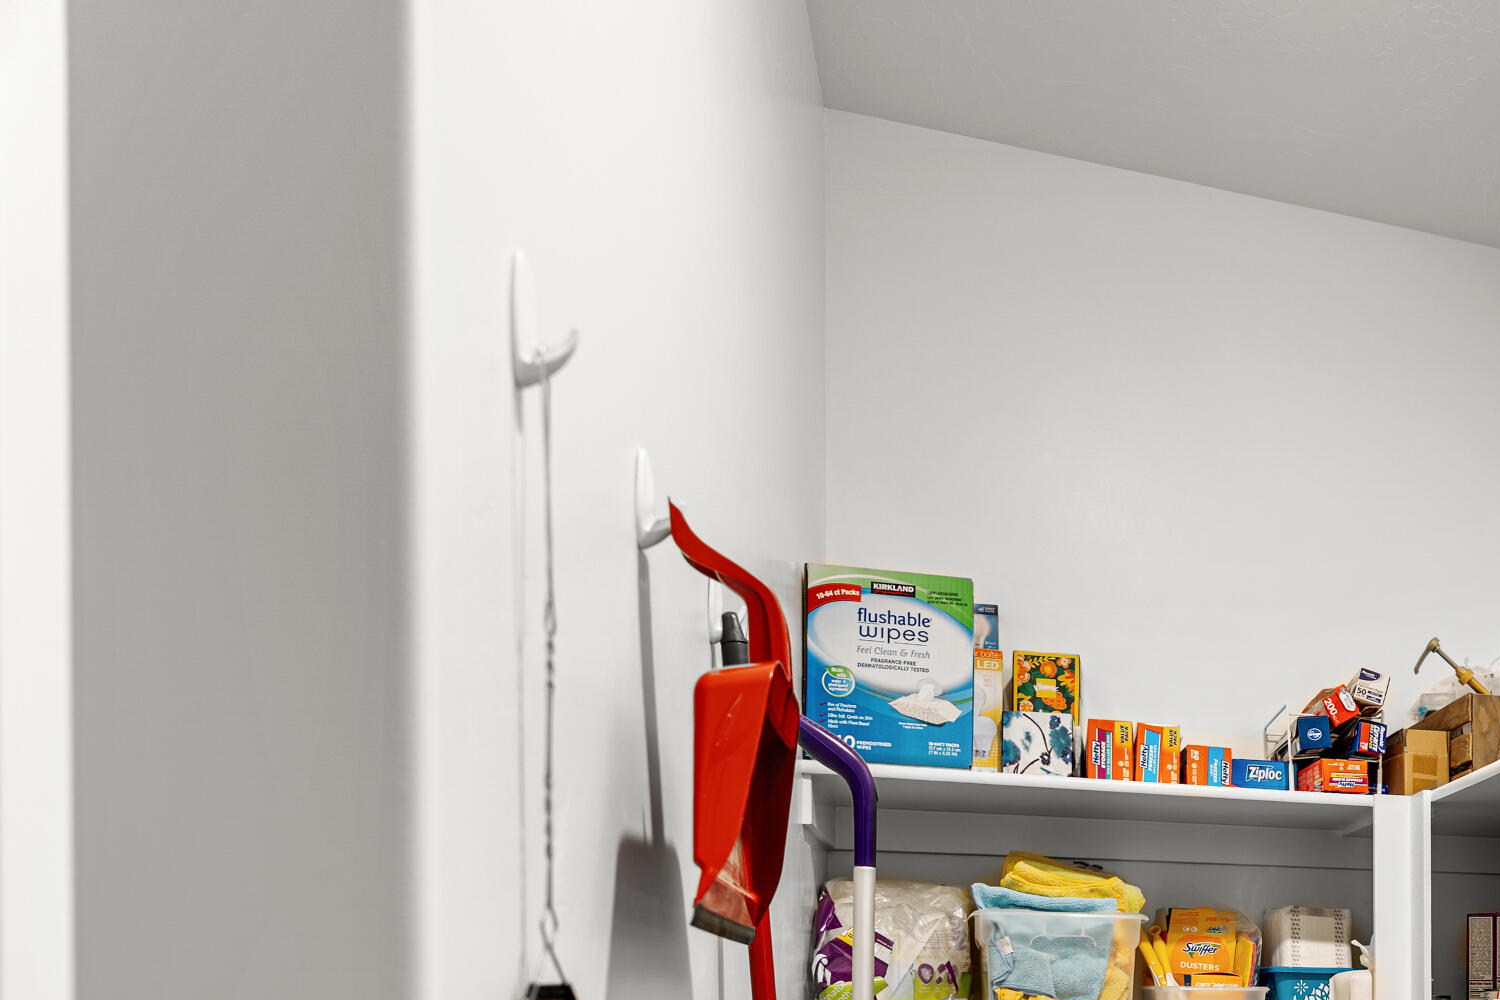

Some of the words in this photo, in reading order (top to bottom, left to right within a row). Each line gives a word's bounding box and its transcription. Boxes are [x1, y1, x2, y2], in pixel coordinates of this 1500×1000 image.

[873, 582, 915, 592] KIRKLAND
[815, 590, 834, 600] 10-64
[841, 588, 860, 596] Packs
[857, 608, 930, 627] flushable
[859, 626, 929, 644] wipes
[857, 646, 871, 655] Feel
[874, 647, 898, 656] Clean
[900, 649, 908, 657] &
[911, 649, 930, 659] Fresh
[858, 662, 909, 672] DERMATOLOGICALLY
[871, 658, 916, 667] FRAGRANCE-FREE
[976, 660, 999, 670] LED
[1357, 687, 1367, 695] 50
[1323, 698, 1338, 716] 200
[1140, 746, 1148, 767] Hefty
[1249, 767, 1282, 782] Ziploc
[1182, 942, 1219, 955] Swiffer
[1180, 961, 1219, 971] DUSTERS
